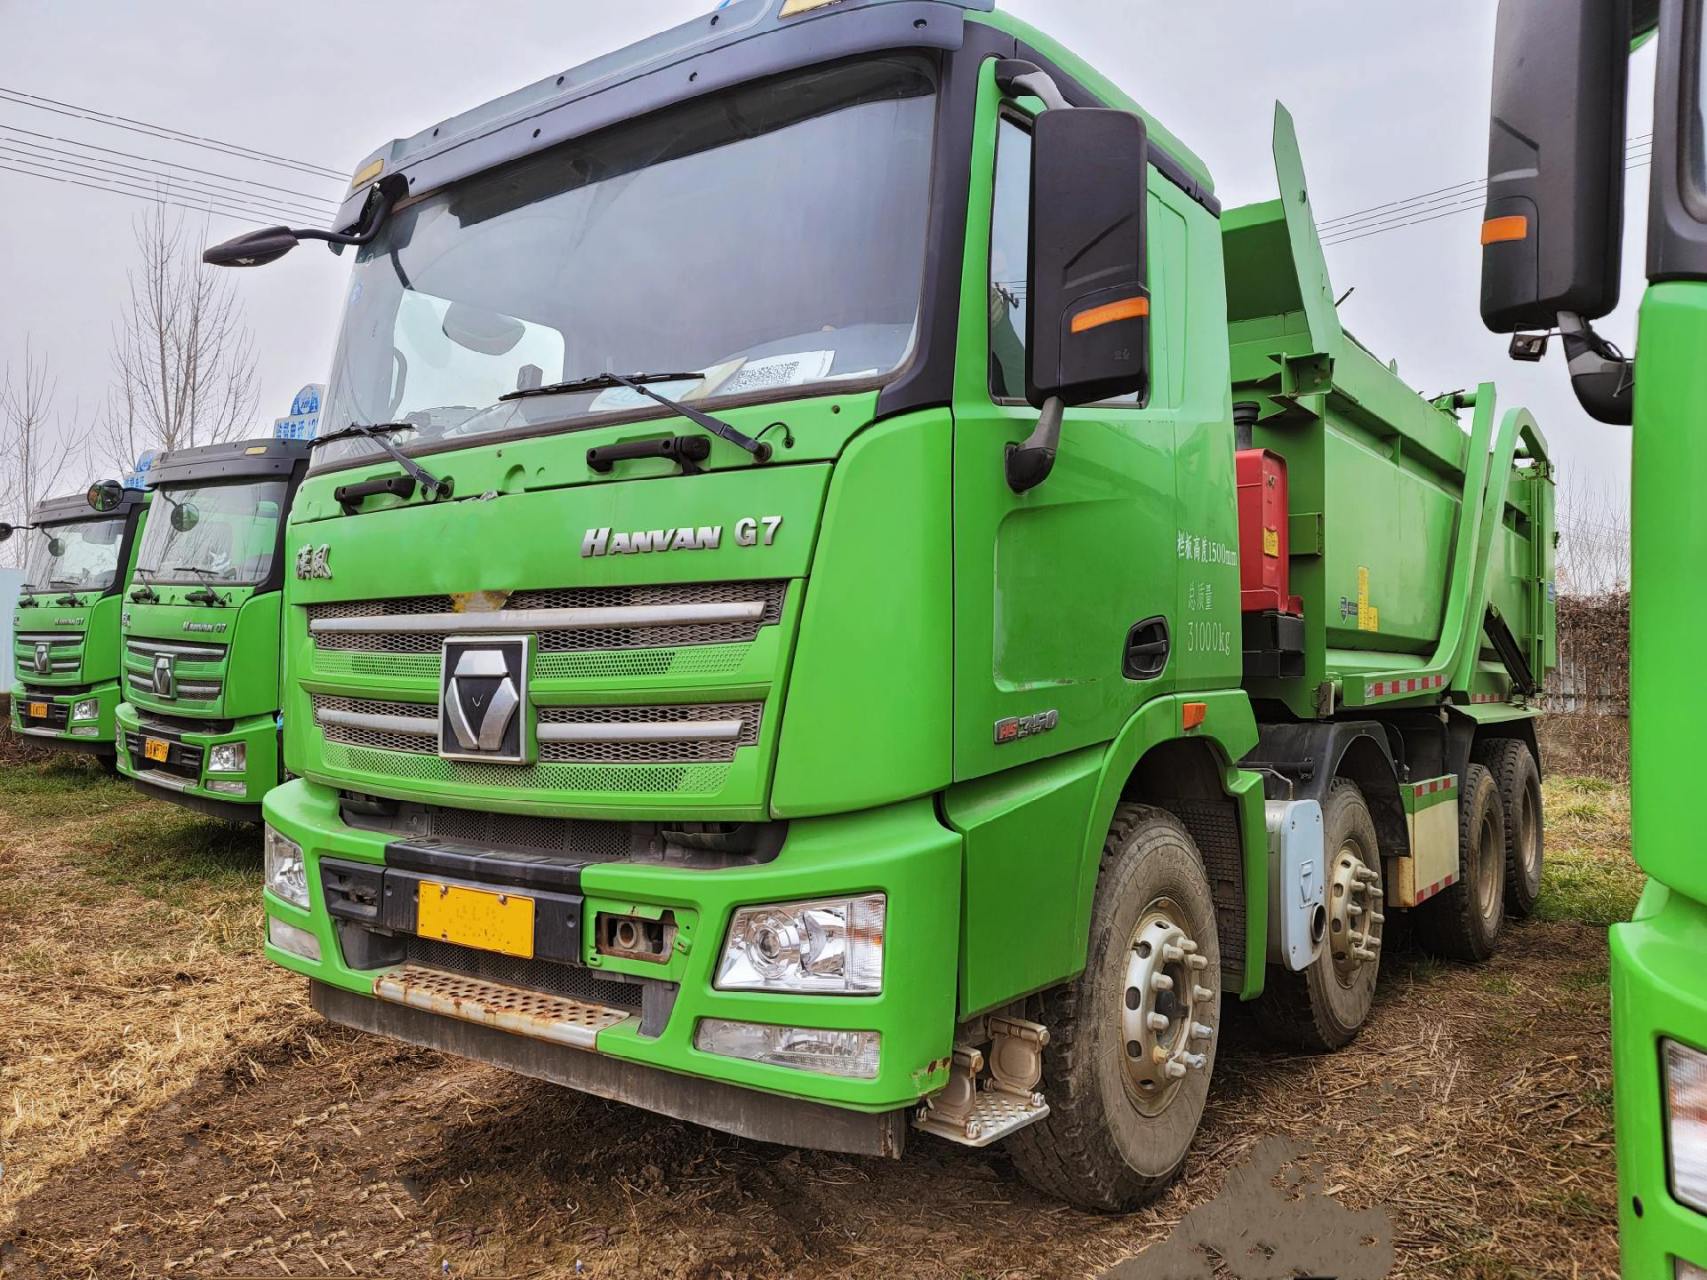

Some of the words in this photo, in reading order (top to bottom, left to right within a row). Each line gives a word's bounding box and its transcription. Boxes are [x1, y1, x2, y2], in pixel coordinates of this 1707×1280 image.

[581, 526, 722, 558] HANVAN
[735, 515, 783, 546] G7
[1188, 581, 1213, 611] 总质量
[1188, 621, 1231, 656] 31000kg
